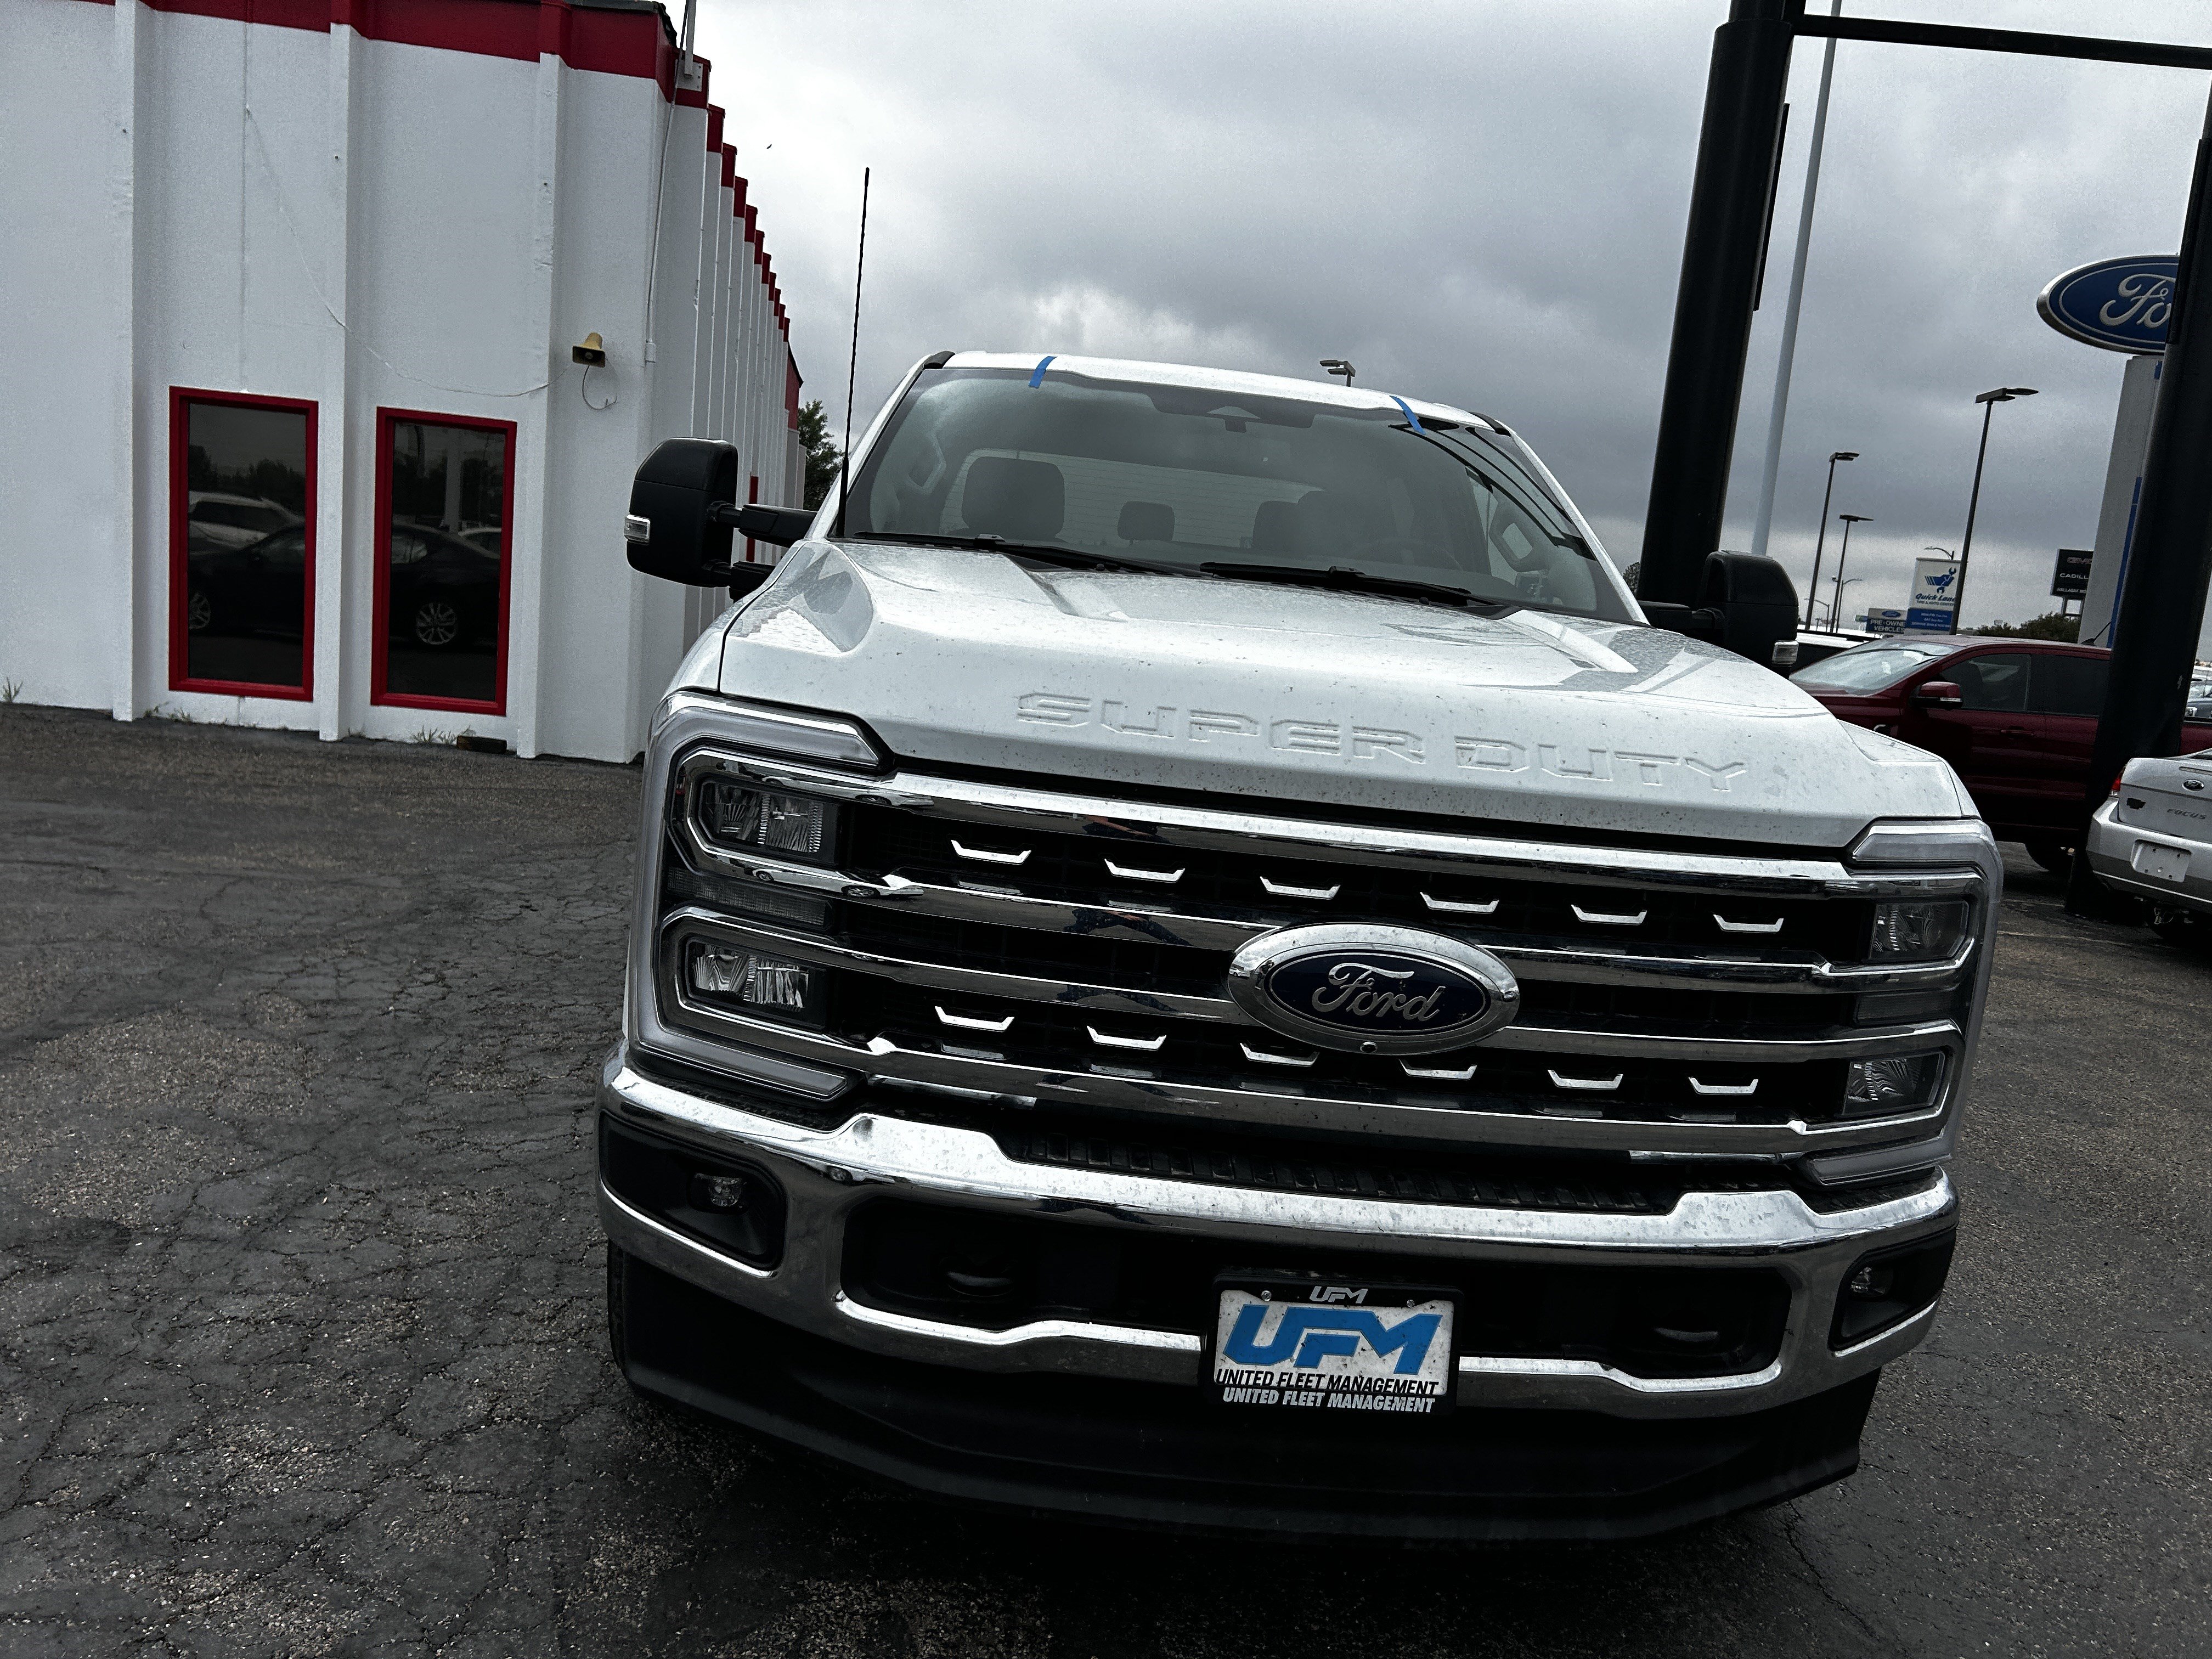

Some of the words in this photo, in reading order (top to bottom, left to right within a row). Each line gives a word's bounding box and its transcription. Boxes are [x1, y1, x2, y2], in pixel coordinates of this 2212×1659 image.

[1015, 692, 1426, 765] SUPER
[1454, 735, 1747, 792] DUTY
[2167, 808, 2207, 819] FOCUS
[1312, 962, 1446, 1022] Ford
[1308, 1286, 1369, 1304] UFM
[1222, 1304, 1443, 1376] UFM
[1216, 1368, 1275, 1387] UNITED
[1276, 1372, 1326, 1389] FLEET
[1326, 1374, 1440, 1396] MANAGEMENT
[1222, 1387, 1279, 1406] UNITED
[1282, 1390, 1325, 1408] FLEET
[1326, 1392, 1435, 1413] MANAGEMENT
